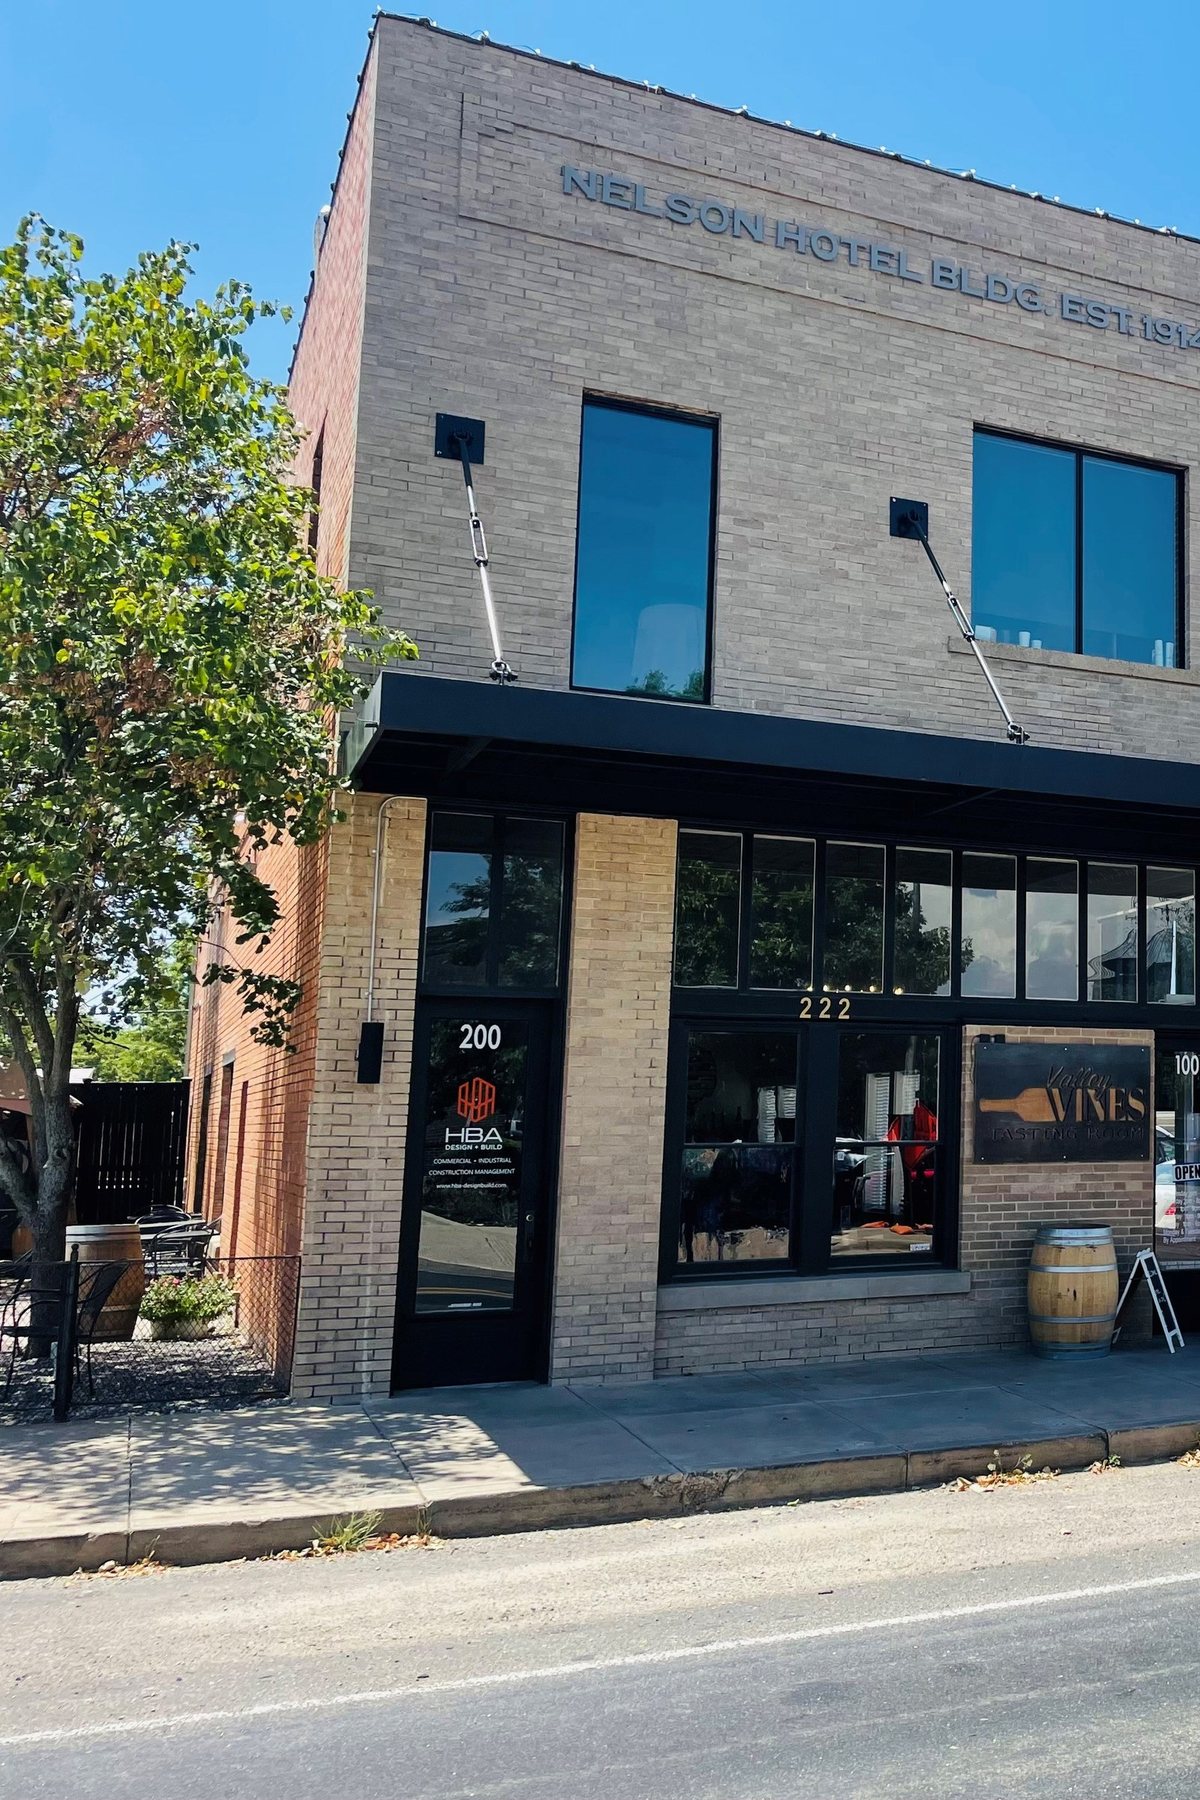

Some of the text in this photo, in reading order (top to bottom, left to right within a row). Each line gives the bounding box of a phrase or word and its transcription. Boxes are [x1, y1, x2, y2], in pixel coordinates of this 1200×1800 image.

[561, 165, 765, 243] NELSON
[775, 219, 924, 284] HOTEL
[932, 256, 1055, 316] BLDG.
[1060, 292, 1135, 337] EST.
[799, 996, 851, 1020] 222
[459, 1023, 501, 1050] 200
[1175, 1055, 1199, 1076] 100
[1046, 1065, 1113, 1097] Valley
[1045, 1087, 1145, 1123] VINES
[445, 1127, 503, 1143] HBA
[992, 1126, 1144, 1142] TASTING ROOM
